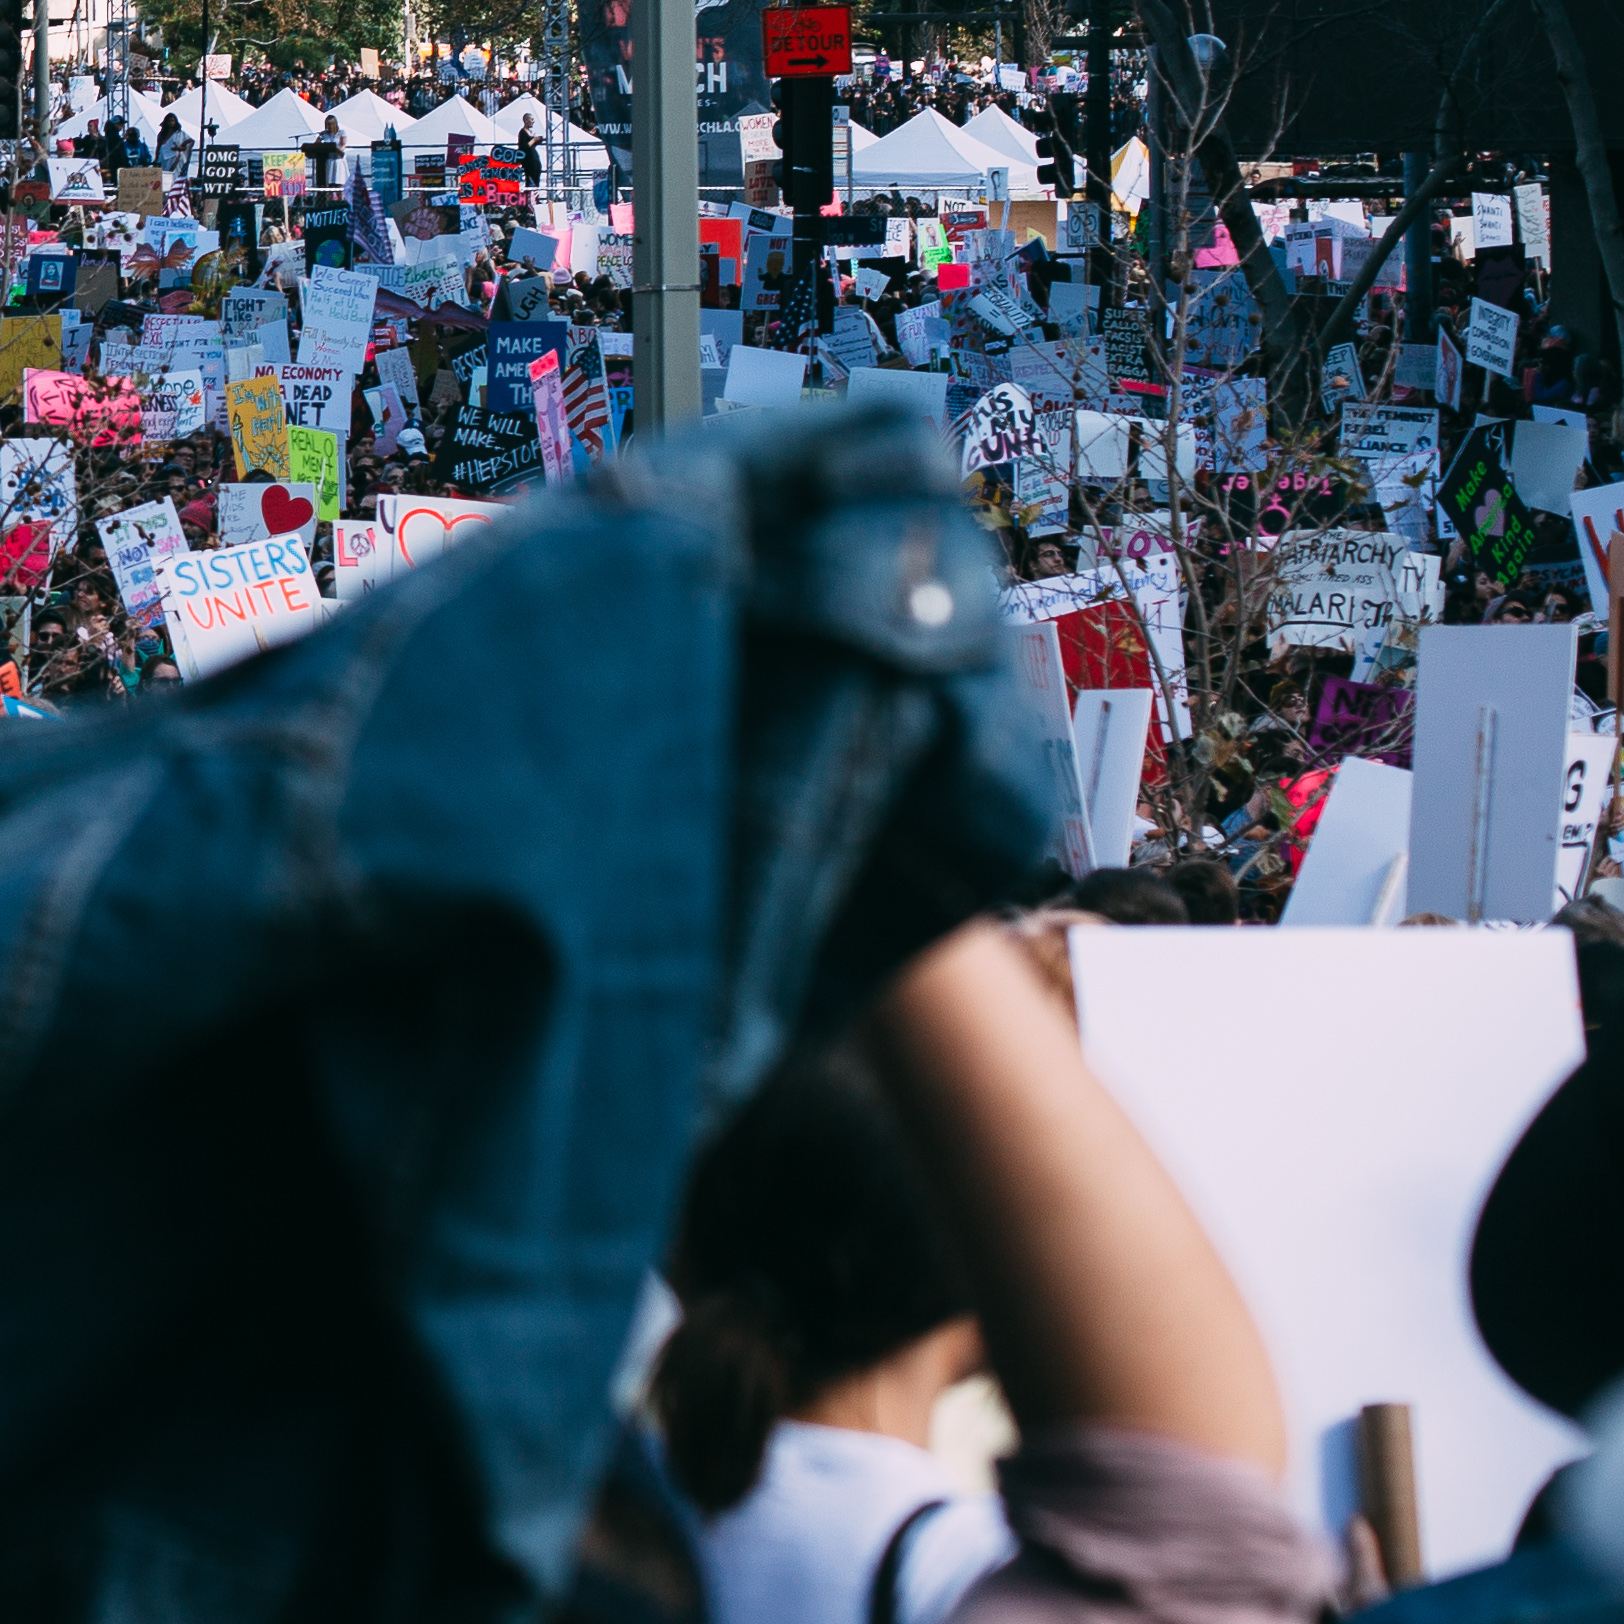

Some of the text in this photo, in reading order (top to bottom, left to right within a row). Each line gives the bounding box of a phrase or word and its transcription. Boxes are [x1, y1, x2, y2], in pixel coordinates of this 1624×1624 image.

[771, 35, 845, 53] DETOUR
[741, 116, 773, 131] WOMEN
[207, 151, 238, 163] OMG
[264, 155, 288, 168] KEEP
[492, 148, 526, 165] GOP
[205, 165, 238, 178] GOP
[204, 182, 233, 194] WTF
[264, 182, 280, 197] MY
[459, 182, 527, 207] IS A BITCH
[943, 200, 967, 213] NOT
[305, 209, 349, 229] MOTHER
[769, 238, 788, 251] NOT
[315, 268, 372, 287] We Cannot
[225, 299, 266, 311] FIGHT
[310, 292, 343, 307] Half of
[514, 286, 545, 321] UGH
[983, 285, 1033, 330] EQUALITY
[225, 310, 252, 322] Like
[329, 308, 350, 320] Held
[1477, 304, 1511, 326] INTEGRITY
[496, 337, 542, 354] MAKE
[1472, 326, 1510, 350] COMPASSION
[451, 344, 489, 383] RESIST
[1104, 353, 1144, 366] EXTRA
[255, 363, 342, 381] NO ECONOMY
[293, 385, 332, 401] DEAD
[252, 410, 282, 438] Her!
[458, 405, 524, 436] WE WILL
[1378, 410, 1435, 424] FEMINIST
[290, 429, 318, 454] REAL
[1454, 460, 1487, 512] Make
[1490, 517, 1523, 564] Kind
[174, 538, 308, 597] SISTERS
[187, 577, 310, 630] UNITE
